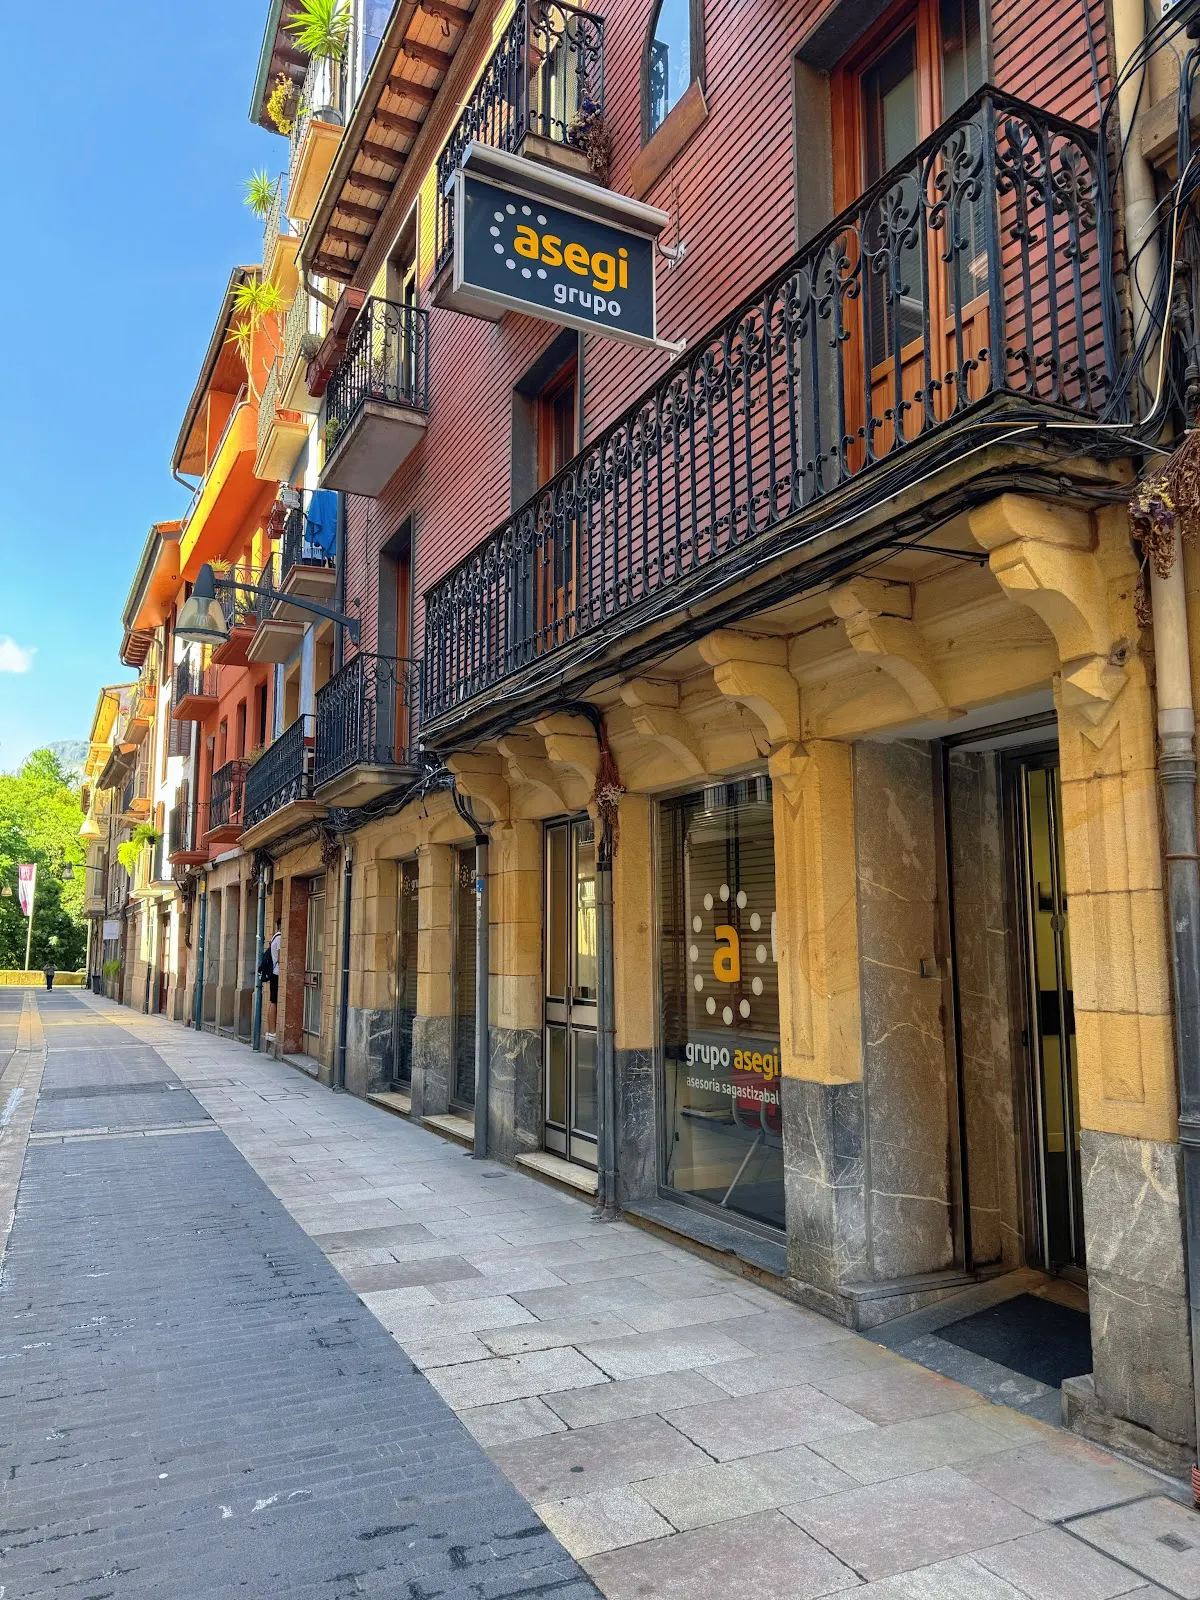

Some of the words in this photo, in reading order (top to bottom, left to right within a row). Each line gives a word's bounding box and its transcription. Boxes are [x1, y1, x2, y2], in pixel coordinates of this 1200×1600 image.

[513, 224, 628, 292] asegi
[553, 283, 621, 317] grupo
[712, 924, 741, 983] a
[685, 1042, 730, 1070] grupo
[733, 1047, 779, 1081] asegi
[686, 1076, 720, 1093] asesoria
[722, 1082, 779, 1105] sagastizabal
